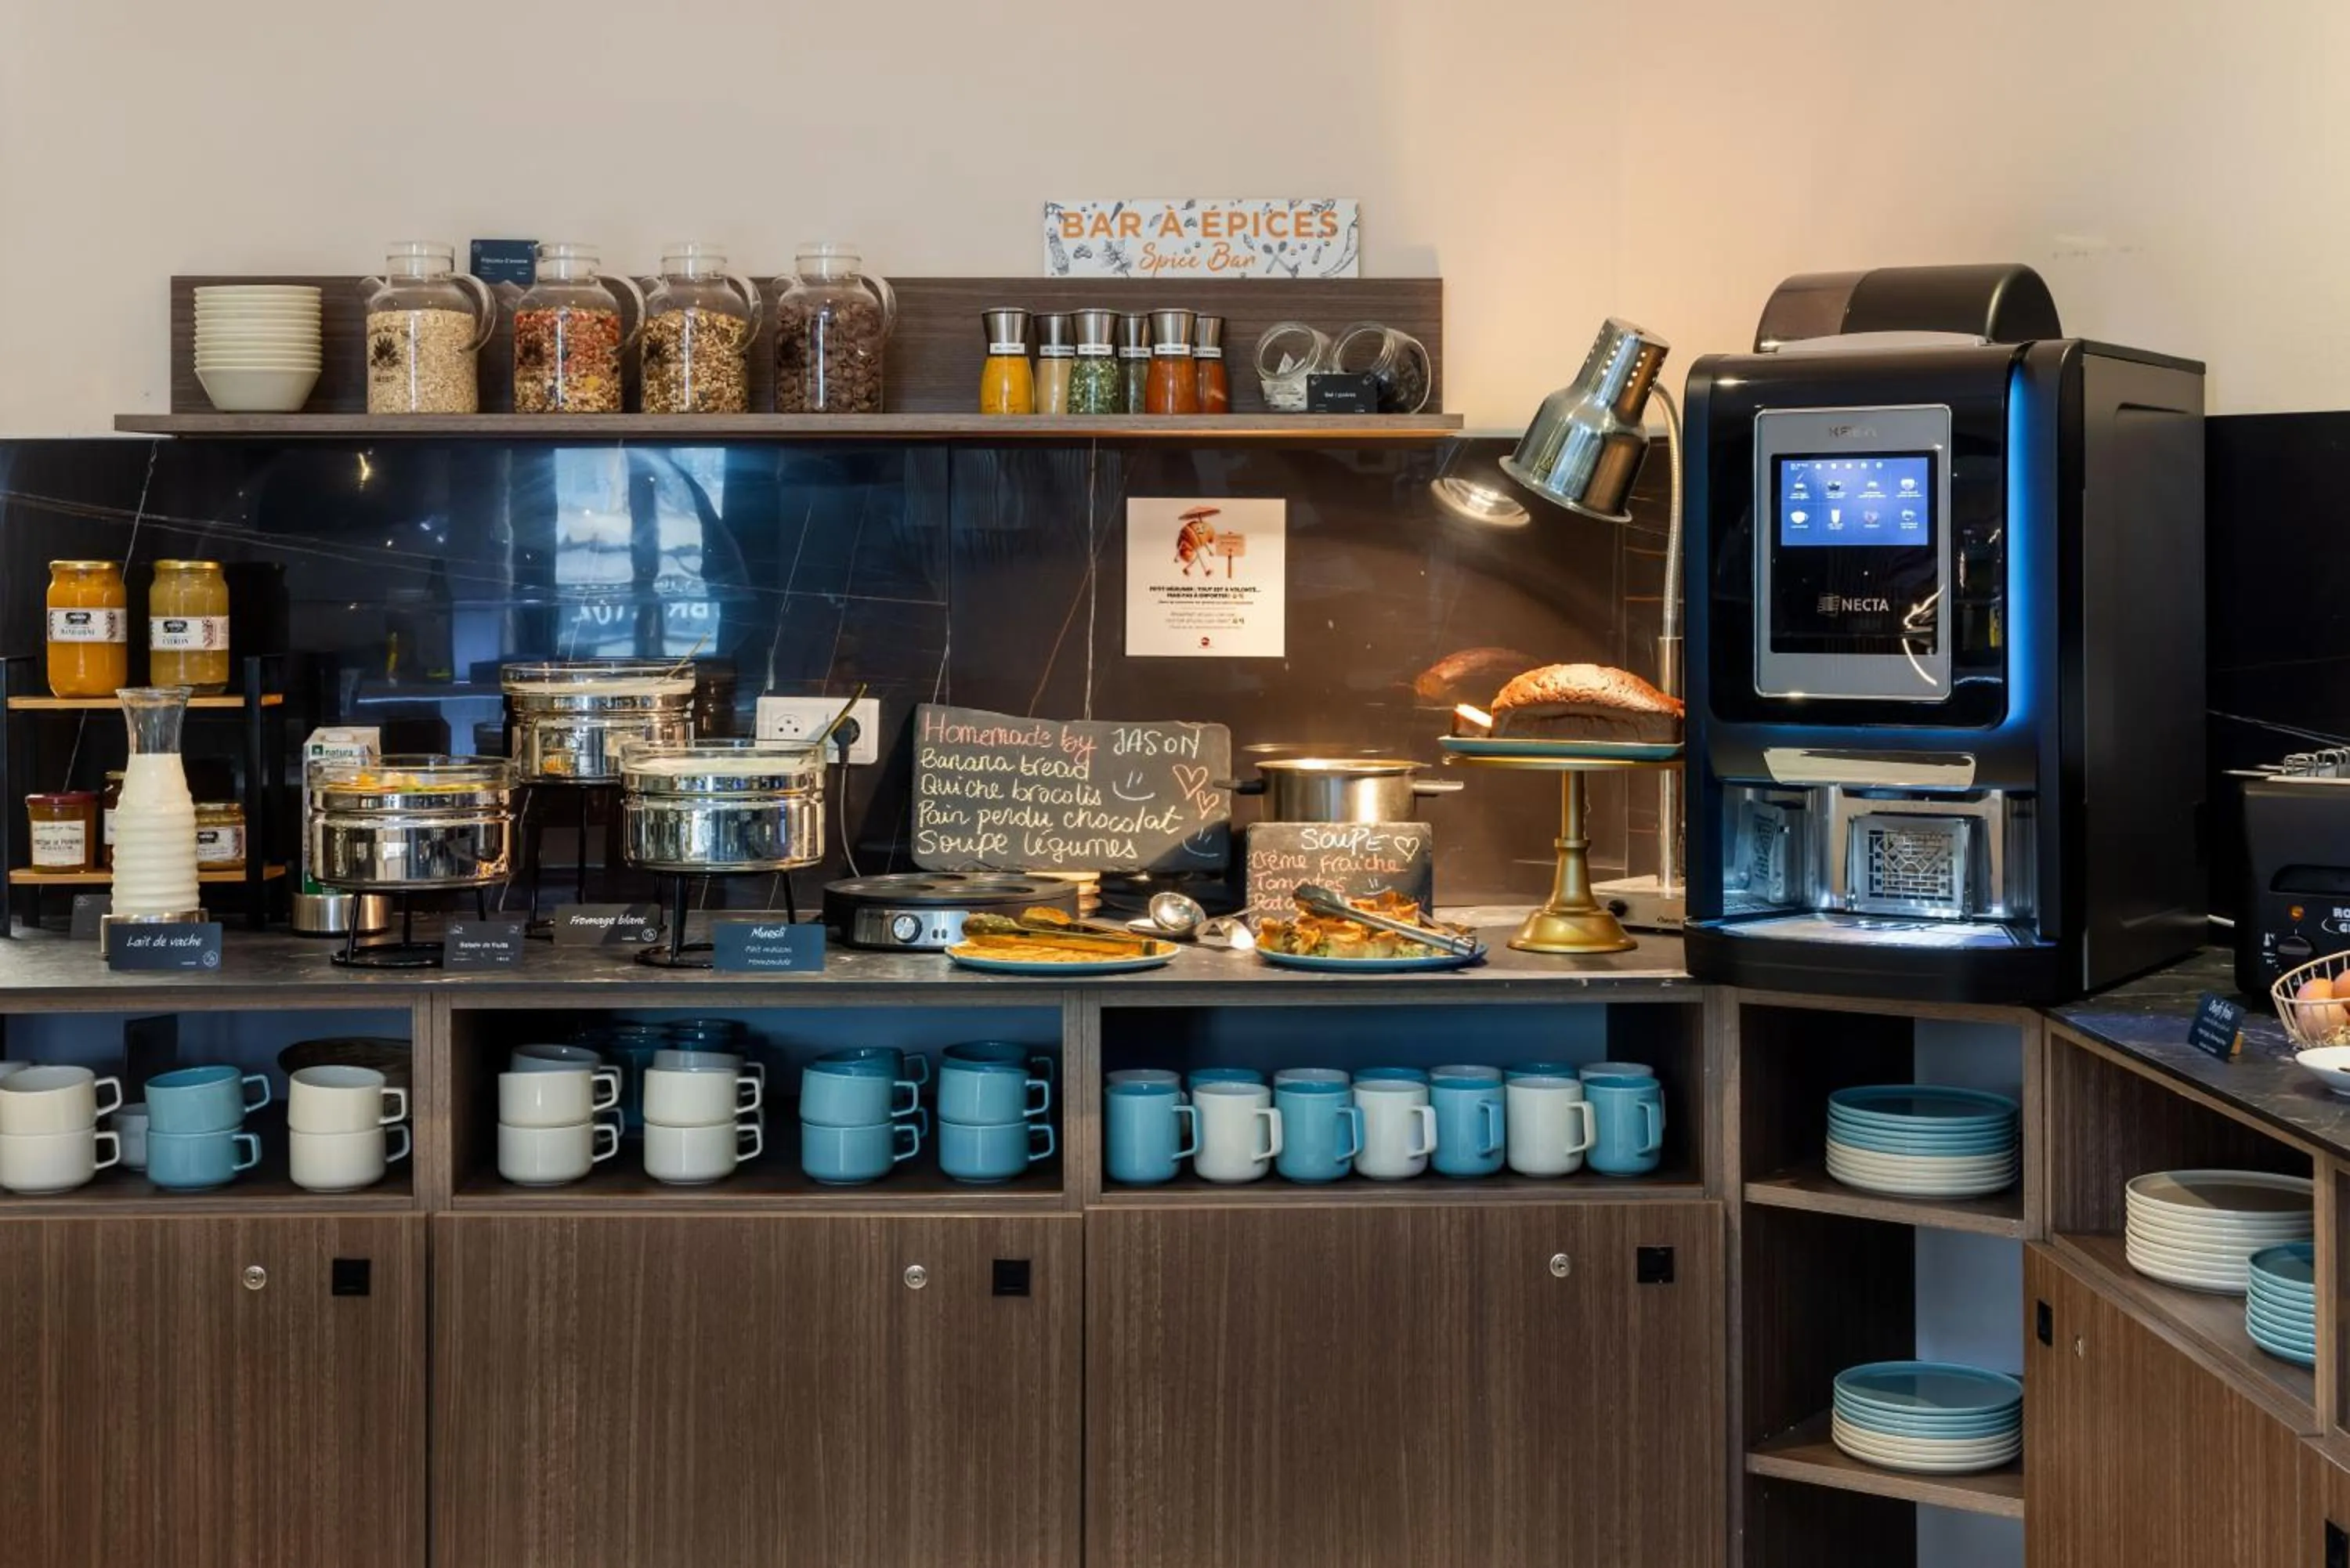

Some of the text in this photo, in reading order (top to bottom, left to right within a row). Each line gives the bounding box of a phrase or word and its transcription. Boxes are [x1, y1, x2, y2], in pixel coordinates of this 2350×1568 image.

[1062, 205, 1339, 239] BAR À ÉPICES
[1139, 242, 1256, 277] Spice Bar
[1842, 598, 1889, 612] NECTA
[923, 711, 1200, 765] Homemade by JASON
[920, 747, 1090, 782] Banana bread
[920, 772, 1102, 806] Quiche brocolis
[917, 799, 1185, 835] Pain perdu chocolat
[916, 827, 1139, 863] Soupe légumes
[569, 914, 647, 928] Fromage blanc
[126, 933, 203, 948] Lait de vache
